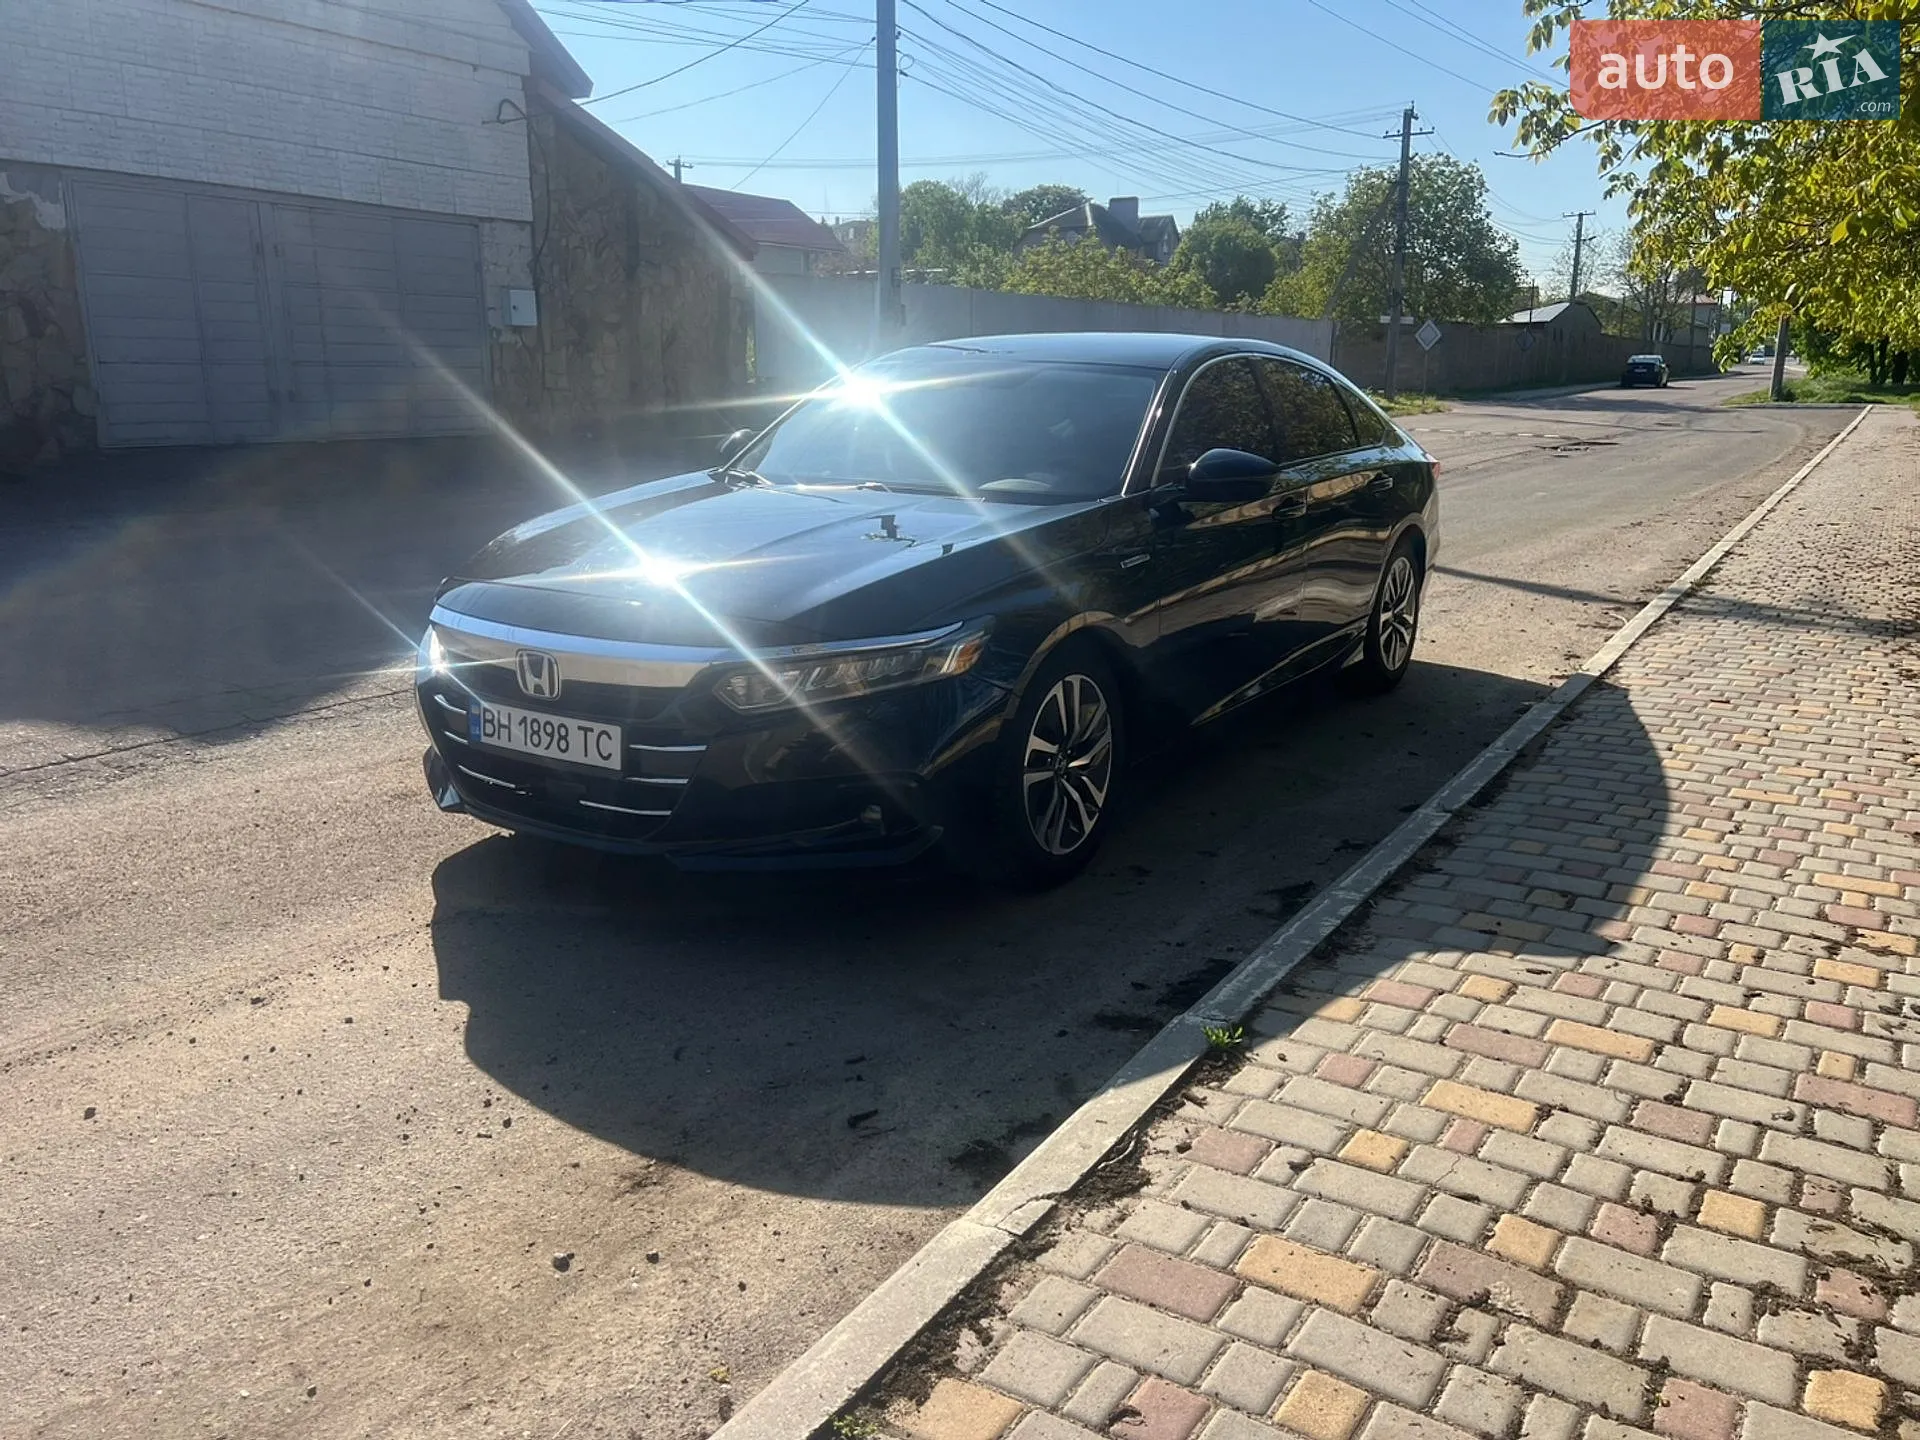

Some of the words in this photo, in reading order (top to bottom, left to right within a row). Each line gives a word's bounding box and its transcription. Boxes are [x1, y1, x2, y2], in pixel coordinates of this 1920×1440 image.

[482, 706, 512, 743] BH
[518, 715, 570, 754] 1898
[577, 725, 613, 761] TC
